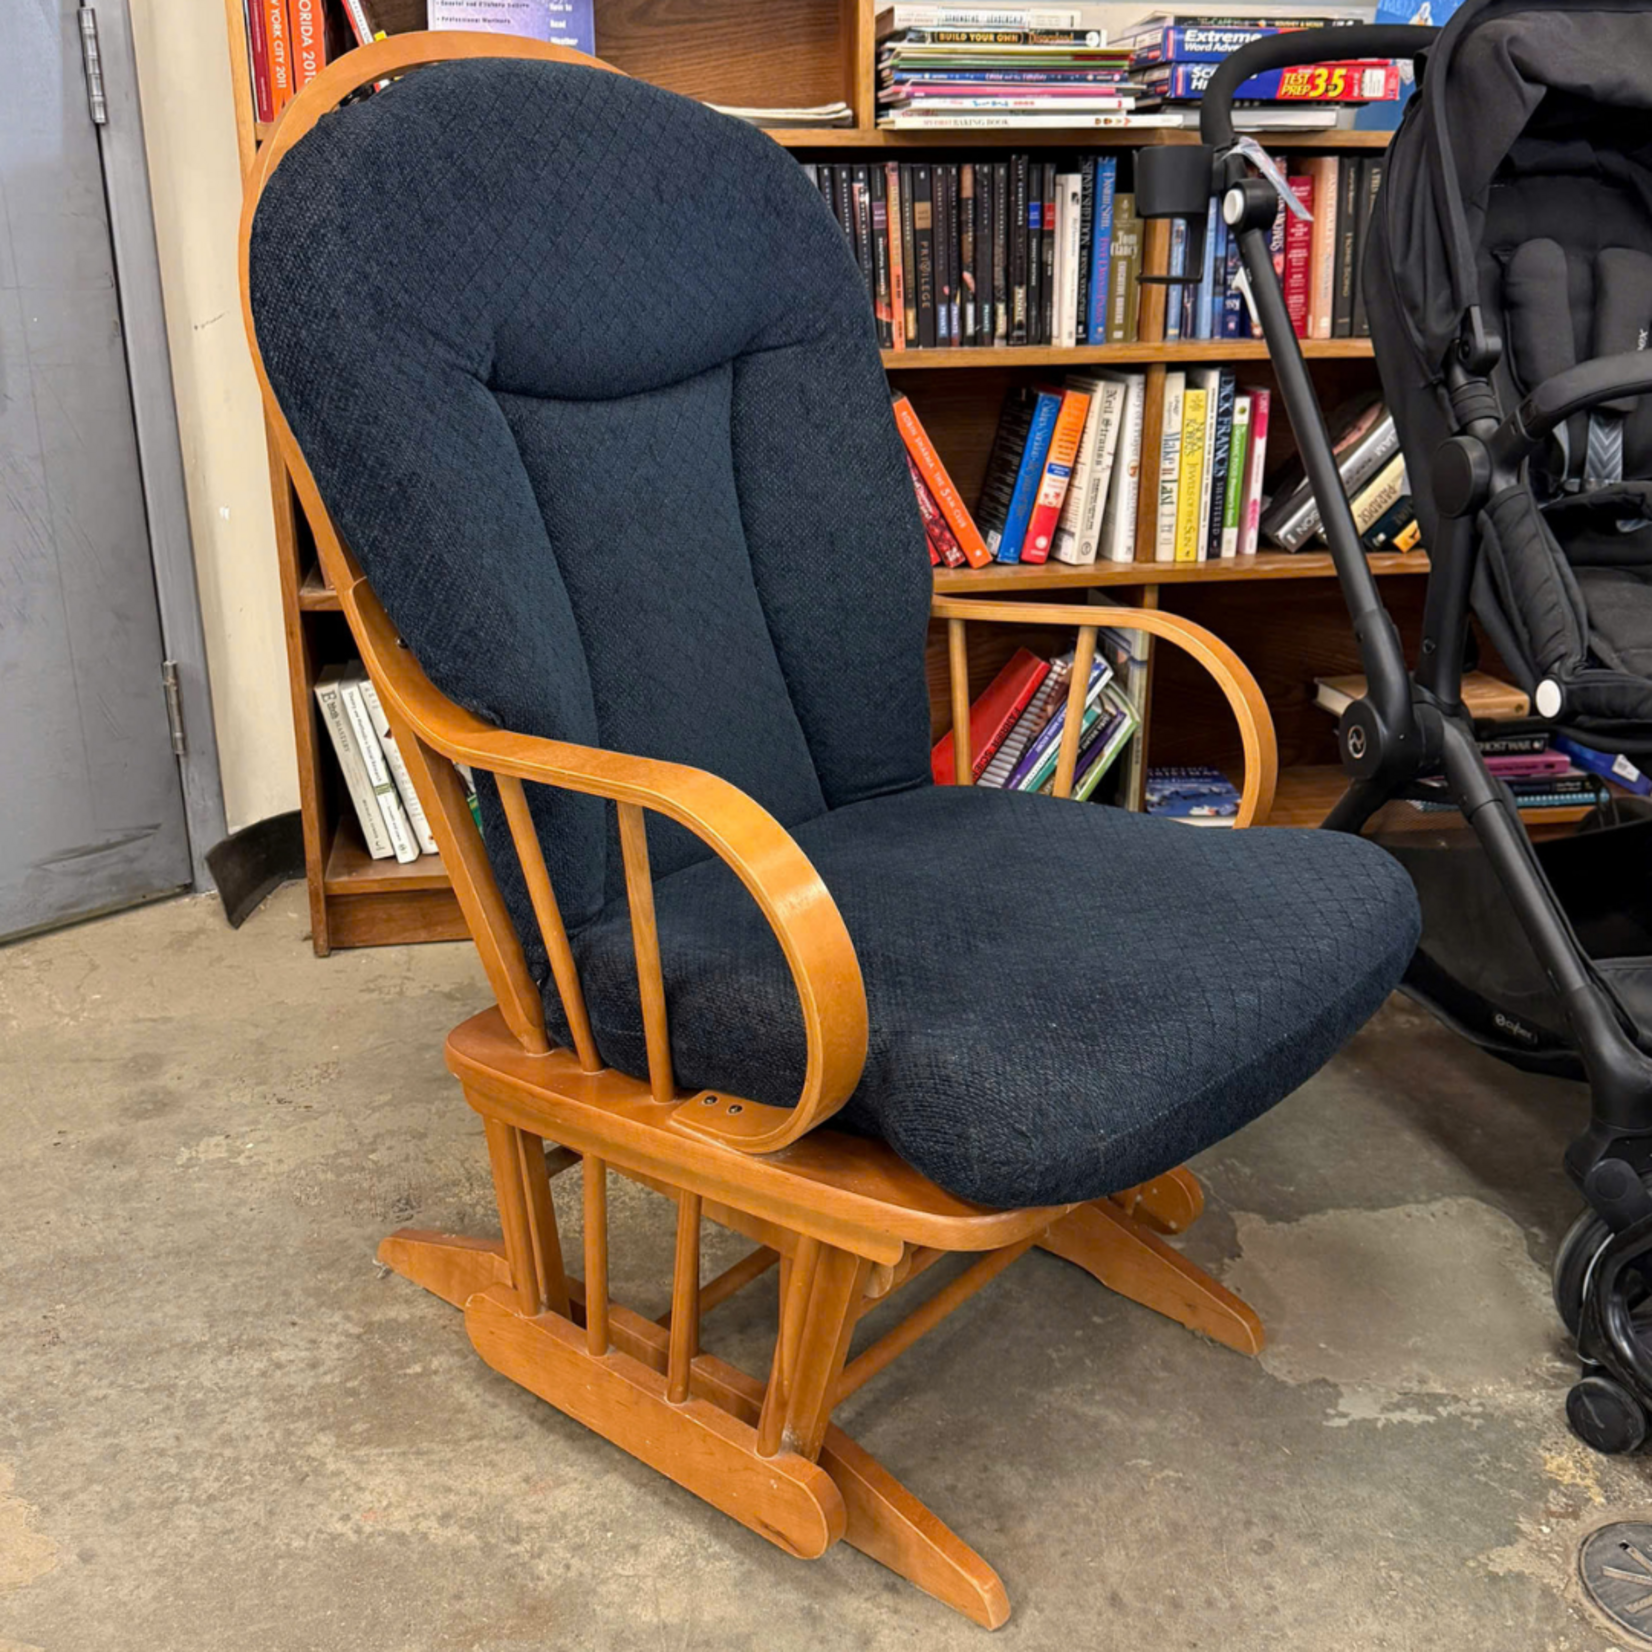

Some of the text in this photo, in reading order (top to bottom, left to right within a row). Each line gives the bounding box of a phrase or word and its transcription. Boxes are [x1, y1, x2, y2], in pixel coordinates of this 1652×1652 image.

[271, 8, 282, 38] YORK
[939, 32, 965, 42] BUILD
[969, 33, 994, 42] YOUR
[997, 34, 1019, 42] OWN
[1185, 30, 1262, 42] Extreme
[274, 40, 284, 63] CITY
[1184, 43, 1213, 51] Word
[277, 66, 286, 88] 2011
[1281, 85, 1311, 96] PREP
[1284, 73, 1310, 85] TEST
[1081, 161, 1092, 199] SIDNEY
[1080, 199, 1091, 245] SHELDON
[919, 241, 930, 309] PRIVILEGE
[1016, 289, 1024, 321] PRIVATE
[1095, 389, 1117, 466] Neil Strauss
[1192, 420, 1205, 453] NORA
[1162, 431, 1180, 465] Make
[1212, 376, 1235, 535] DICK FRANCIS SHATTERED
[900, 410, 917, 436] ROBIN
[914, 437, 935, 468] SHARMA
[933, 471, 945, 487] THE
[940, 487, 951, 497] 5
[953, 509, 967, 528] CLUB
[1160, 479, 1178, 506] Last
[1355, 484, 1397, 526] PARADISE
[1183, 525, 1195, 547] SUN
[334, 719, 350, 752] MASTERY
[348, 691, 357, 709] Theory
[357, 718, 368, 741] Methods
[366, 745, 374, 760] Social
[371, 760, 382, 782] Research
[992, 706, 1022, 750] FARRIER
[1510, 738, 1532, 751] WAR
